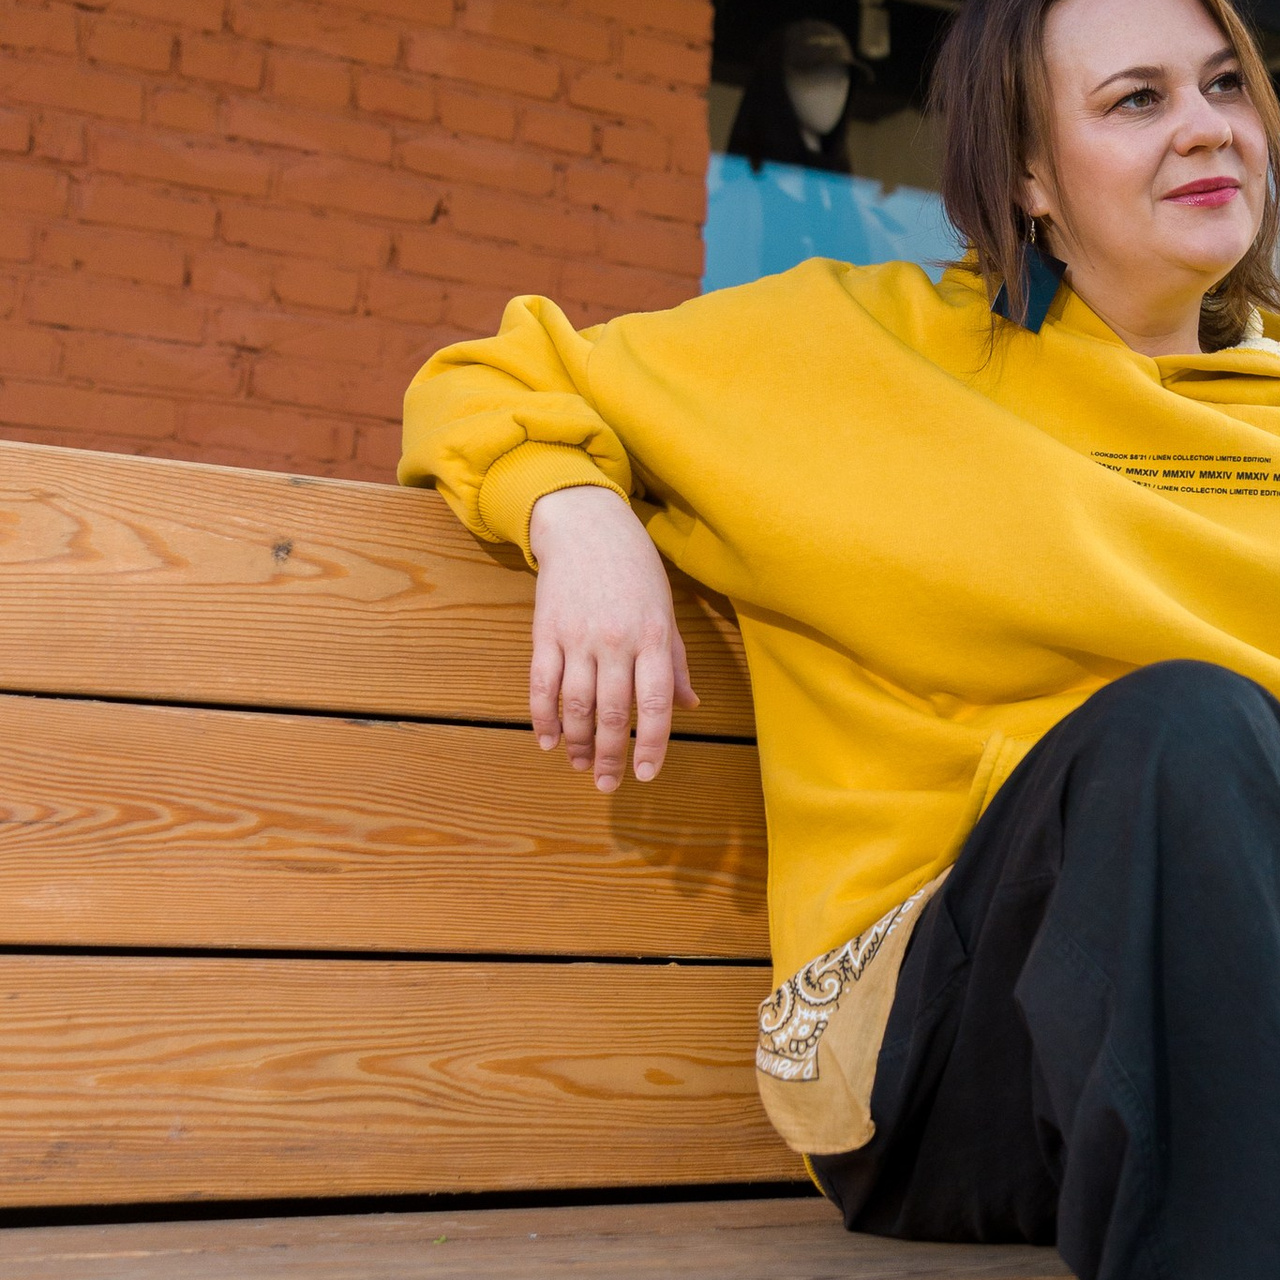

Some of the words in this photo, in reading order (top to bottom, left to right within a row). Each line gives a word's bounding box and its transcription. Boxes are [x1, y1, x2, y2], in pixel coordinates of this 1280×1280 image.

[1090, 451, 1128, 459] LOOKBOOK
[1095, 461, 1121, 472] XIV
[1125, 467, 1159, 477] MMXIV
[1162, 469, 1196, 479] MMXIV
[1199, 470, 1233, 480] MMXIV
[1236, 471, 1270, 481] MMXIV
[1180, 486, 1228, 495] COLLECTION
[1229, 488, 1259, 496] LIMITED
